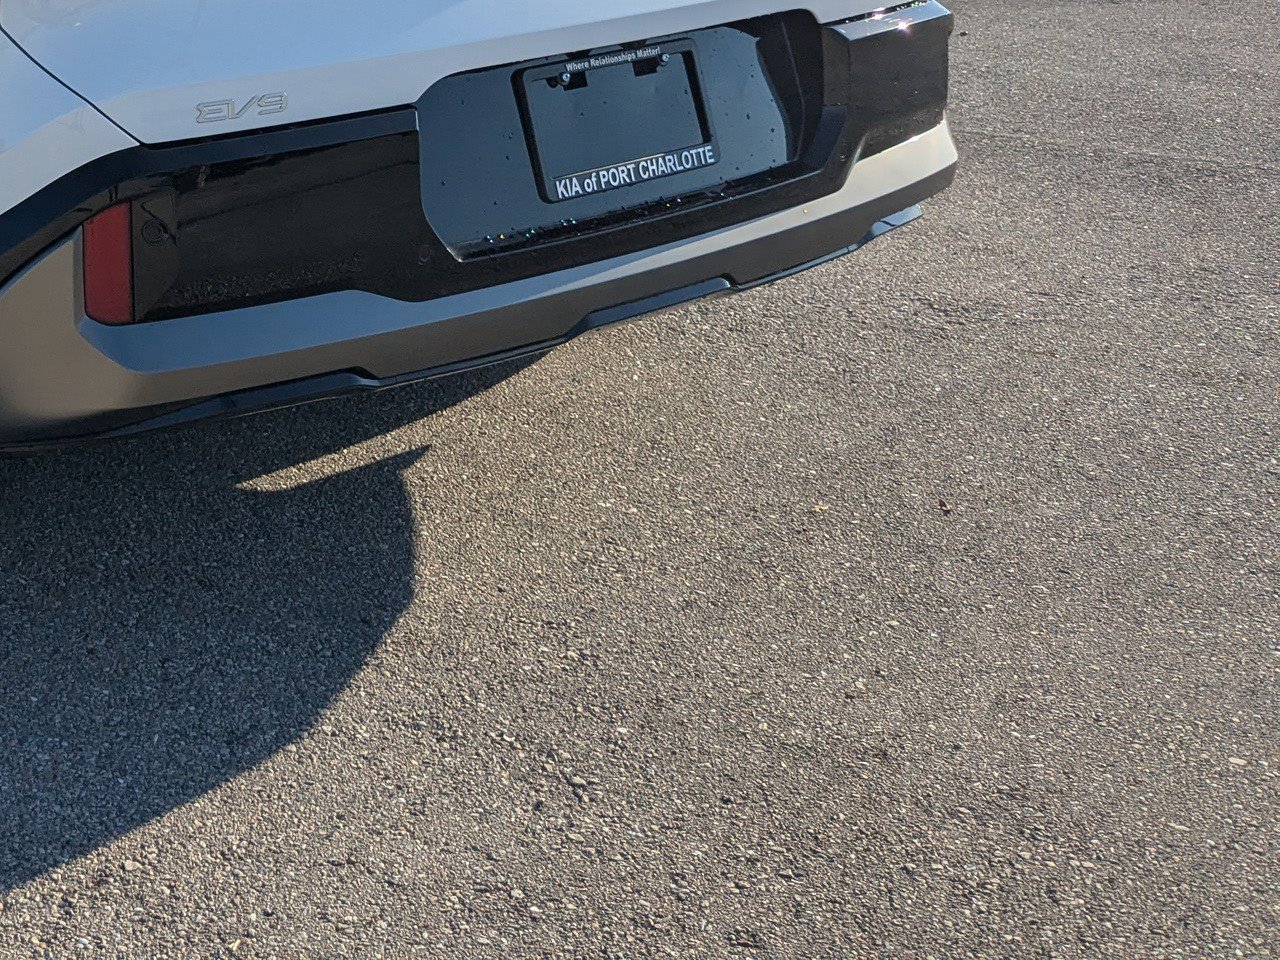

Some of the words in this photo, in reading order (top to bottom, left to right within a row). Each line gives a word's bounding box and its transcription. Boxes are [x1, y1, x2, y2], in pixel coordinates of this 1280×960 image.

[565, 61, 590, 72] Where
[590, 52, 636, 67] Relationships
[636, 46, 661, 58] Matter!
[195, 91, 288, 124] EV9
[555, 177, 582, 199] KIA
[583, 172, 597, 193] of
[599, 163, 636, 189] PORT
[638, 145, 715, 180] CHARLOTTE
